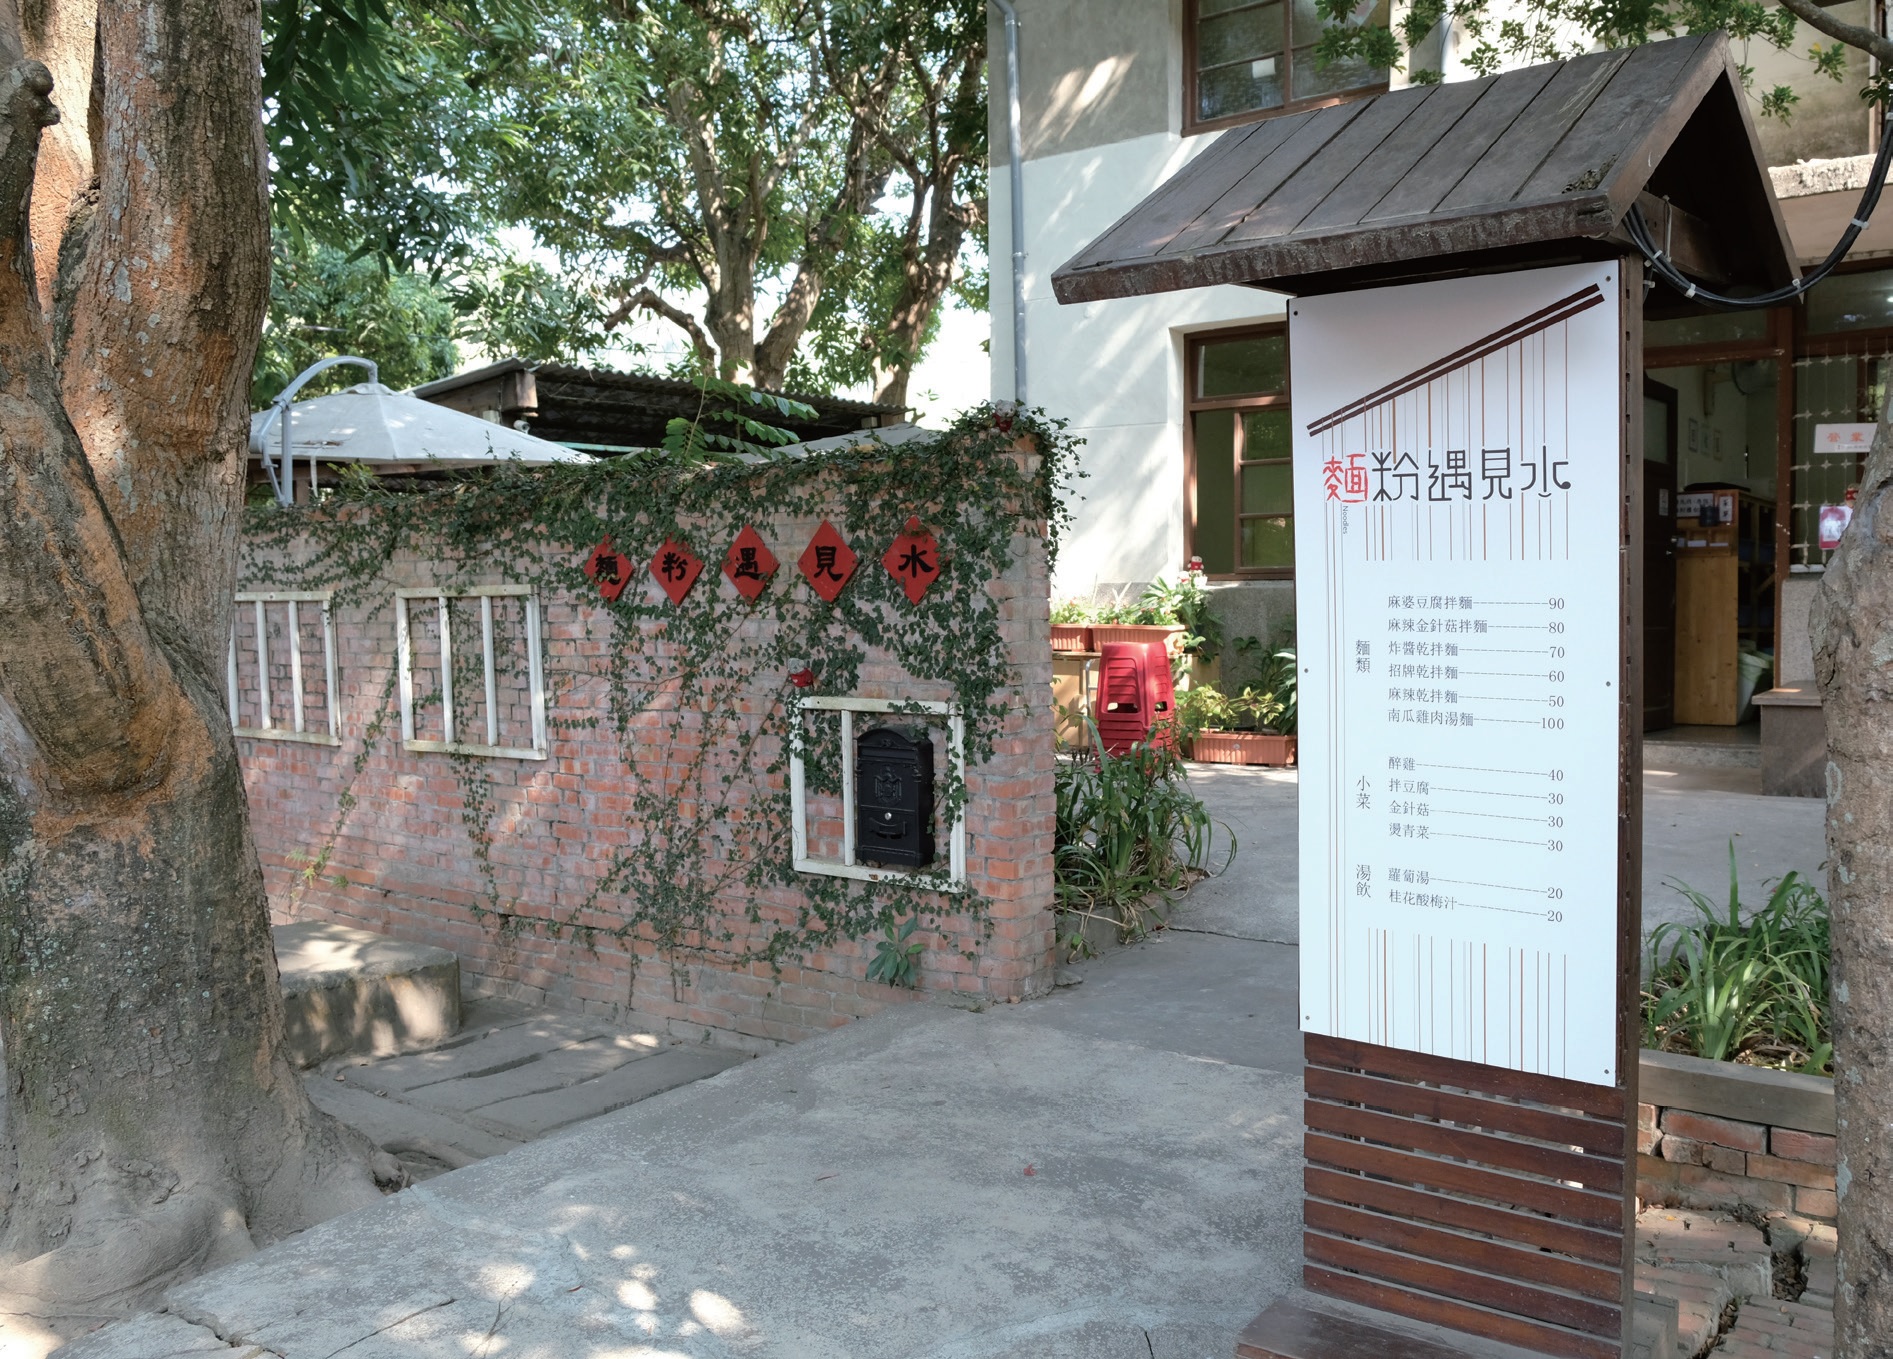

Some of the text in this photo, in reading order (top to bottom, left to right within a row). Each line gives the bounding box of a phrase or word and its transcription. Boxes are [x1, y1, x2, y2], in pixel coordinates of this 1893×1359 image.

[1322, 445, 1571, 503] 麵粉遇見水
[661, 552, 688, 582] 粉
[734, 547, 768, 580] 遇
[813, 545, 844, 582] 見
[898, 544, 935, 578] 水
[1387, 595, 1565, 611] 麻婆豆腐拌麵 90
[1387, 618, 1565, 634] 麻辣金針菇拌麵 80
[1355, 639, 1371, 674] 麵類
[1388, 640, 1565, 658] 炸醬乾拌麵 70
[1388, 663, 1565, 682] 招牌乾拌麵 60
[1388, 687, 1565, 707] 麻辣乾拌麵 50
[1387, 708, 1565, 730] 南瓜雞肉湯麵 100
[1388, 756, 1564, 781] 醉雞 40
[1355, 775, 1371, 810] 小菜
[1388, 778, 1564, 805] 拌豆腐 30
[1388, 800, 1564, 828] 金針菇 30
[1388, 822, 1564, 852] 燙青菜 30
[1355, 863, 1372, 899] 湯飲
[1387, 867, 1563, 900] 蘿蔔湯 20
[1388, 888, 1563, 923] 桂花酸梅汁 20
